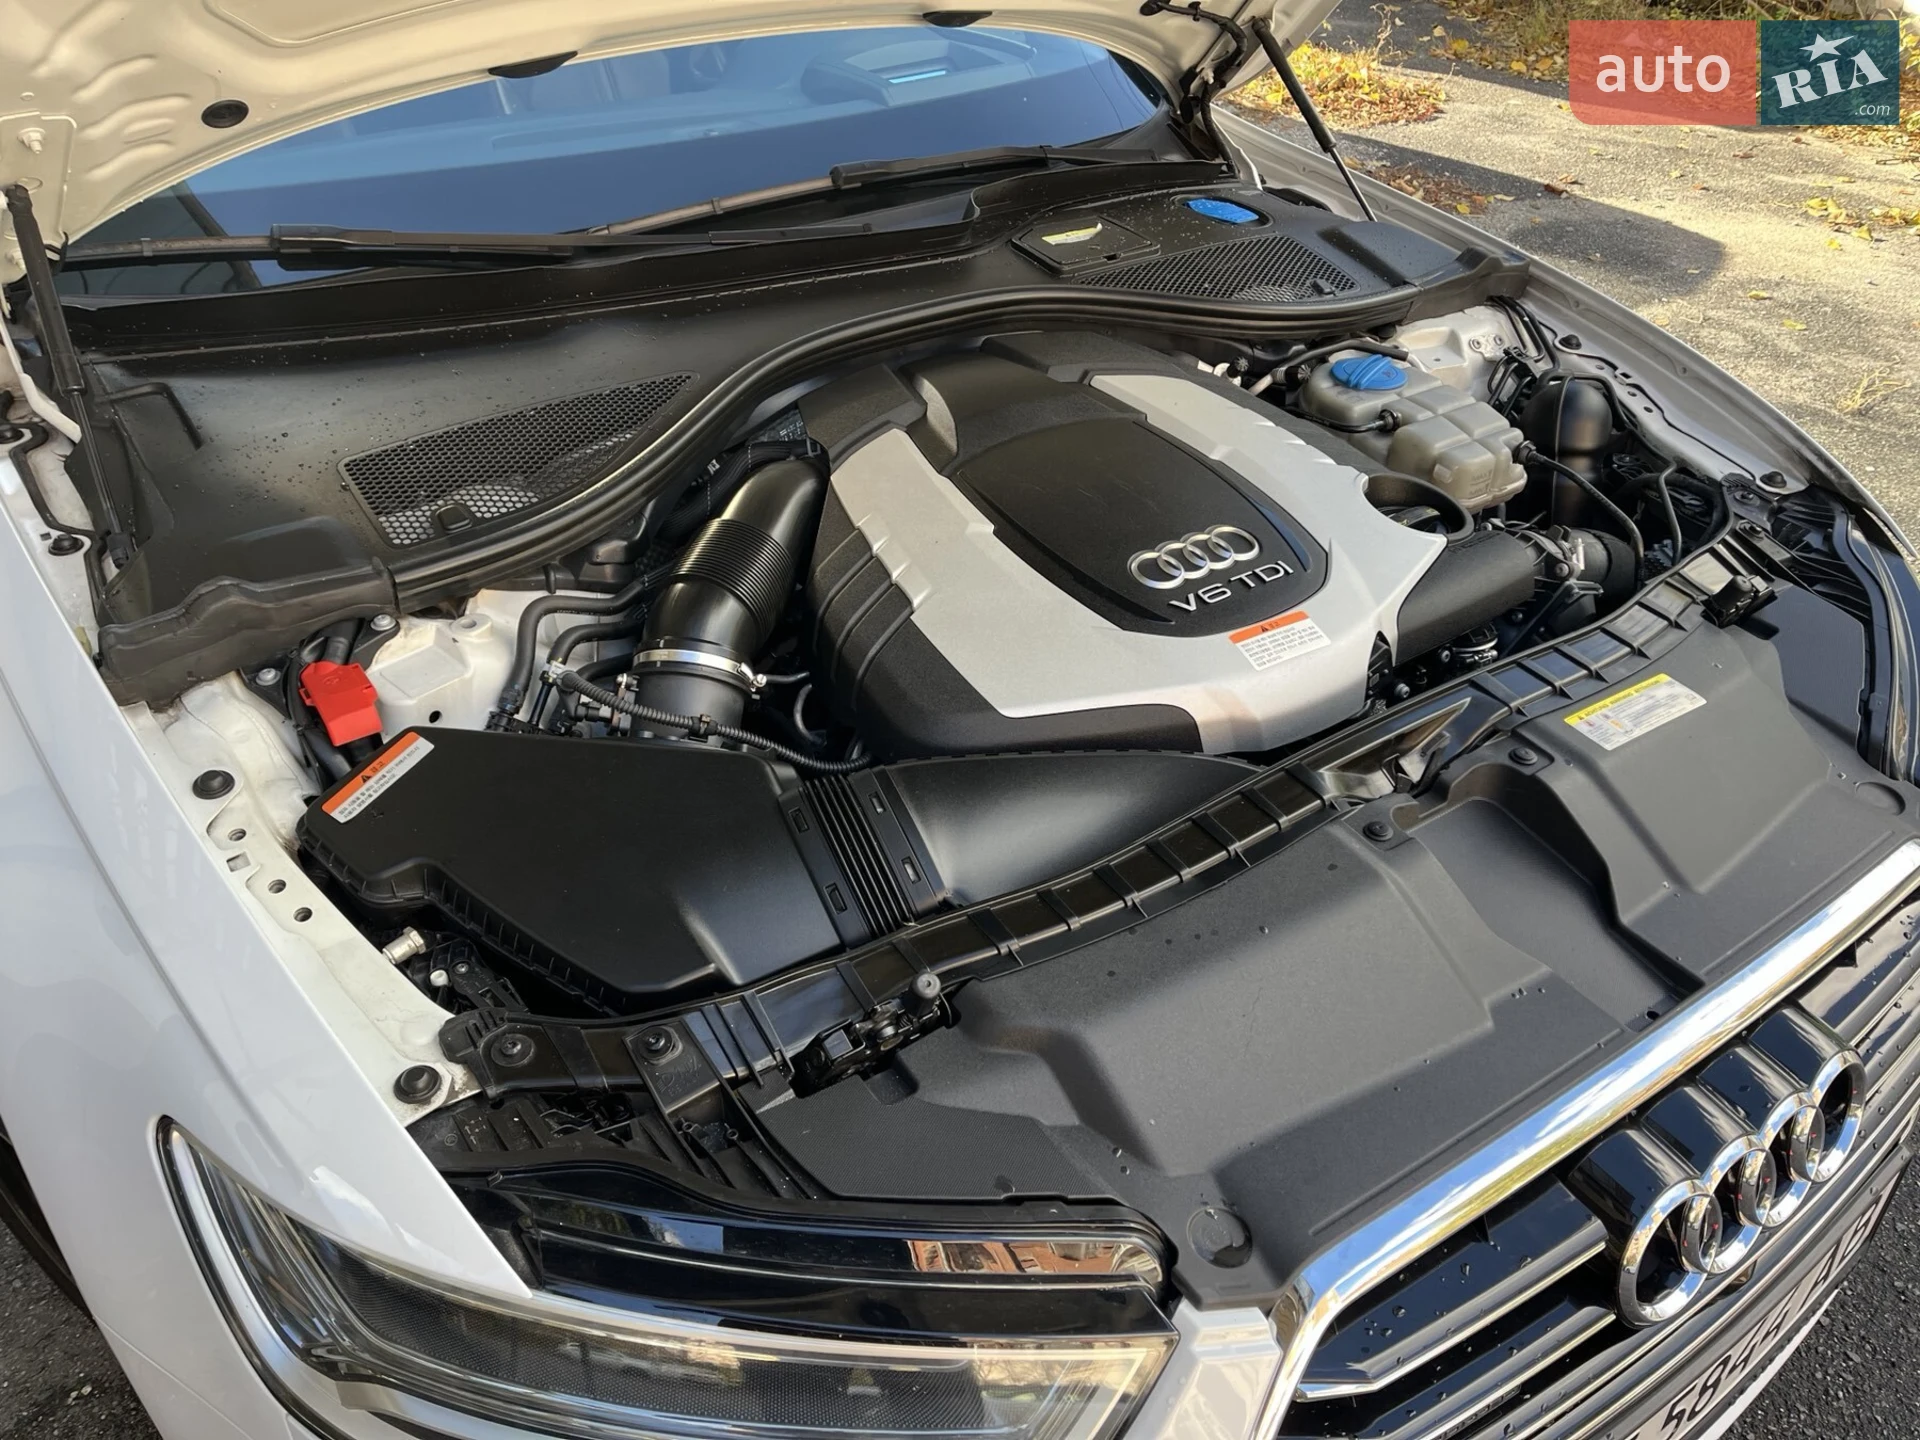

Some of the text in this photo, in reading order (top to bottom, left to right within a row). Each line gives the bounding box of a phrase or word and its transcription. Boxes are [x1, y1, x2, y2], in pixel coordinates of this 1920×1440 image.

[1168, 560, 1295, 612] V6 TDI
[1660, 1285, 1800, 1440] 5844
[1799, 1194, 1884, 1313] AB
